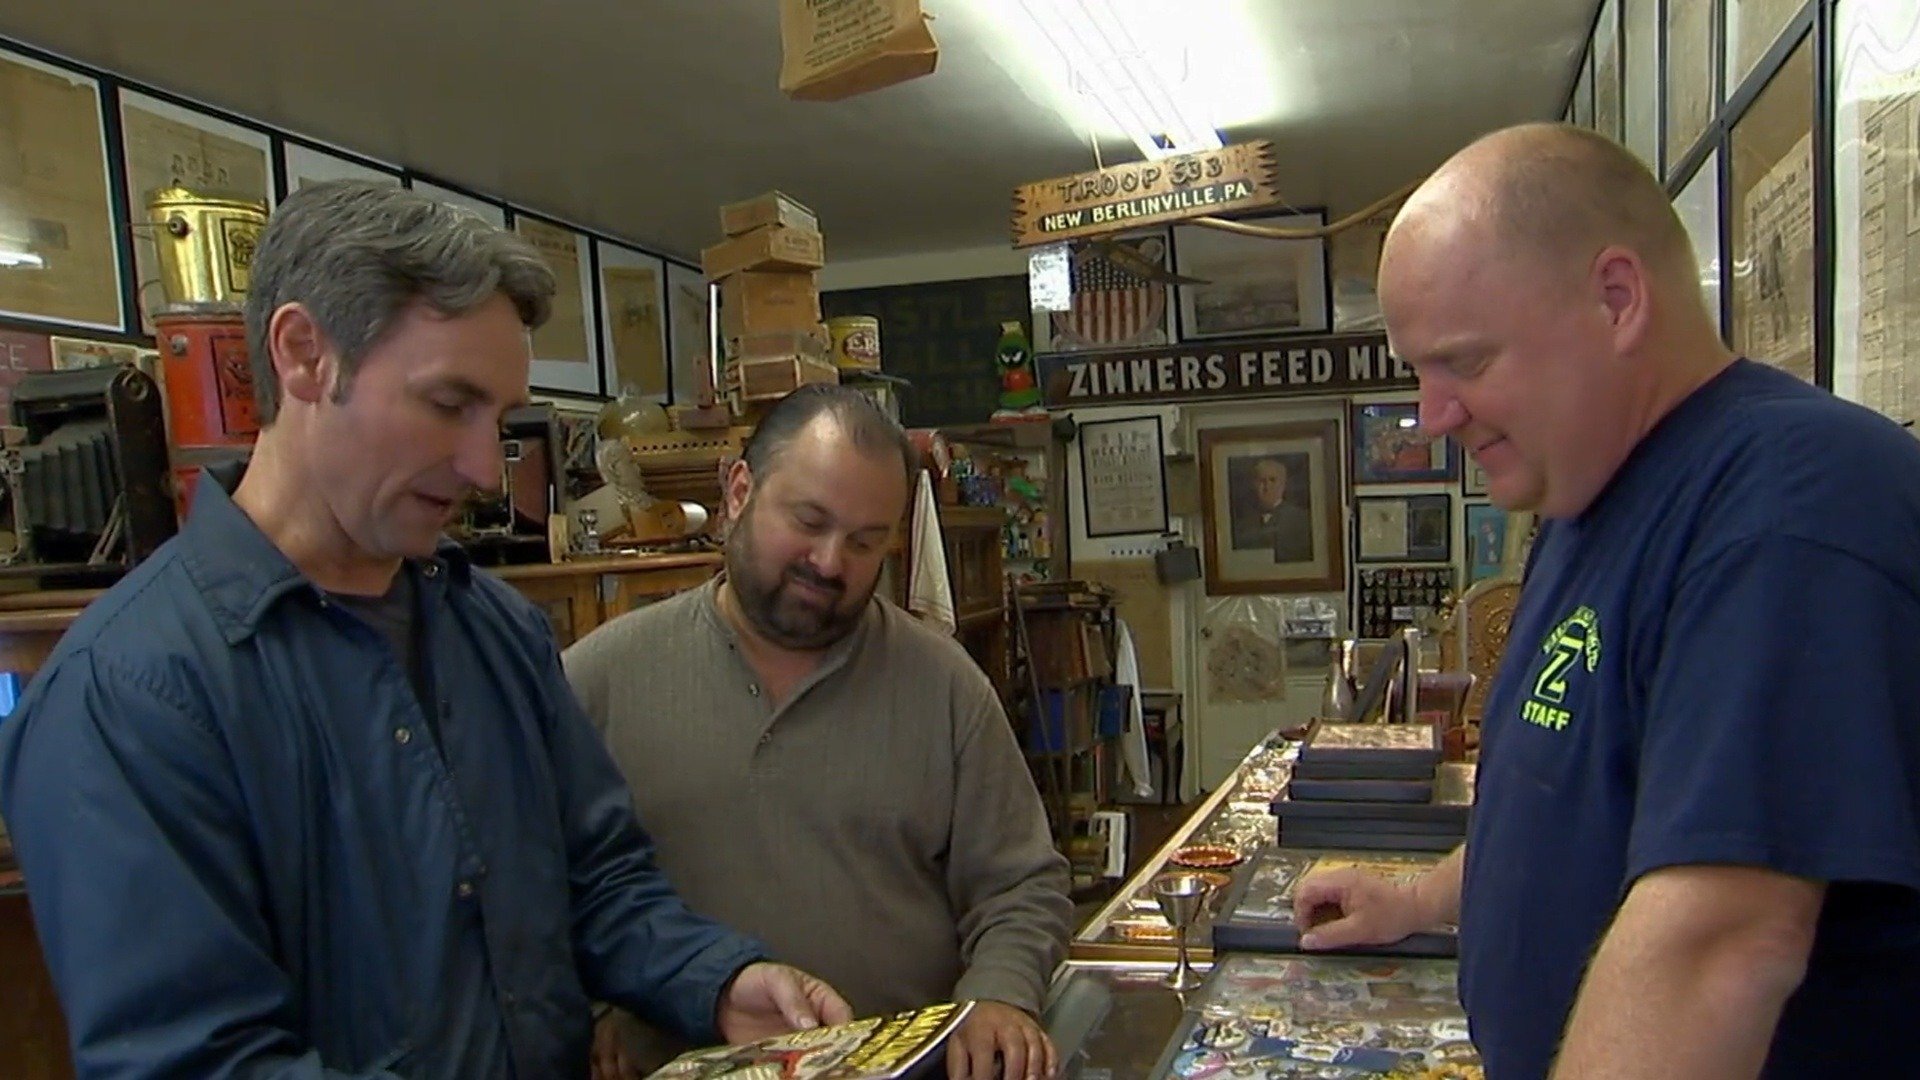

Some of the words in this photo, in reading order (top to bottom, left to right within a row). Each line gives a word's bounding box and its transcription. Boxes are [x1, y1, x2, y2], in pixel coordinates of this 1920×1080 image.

[1057, 166, 1162, 204] TROOP
[1044, 210, 1083, 231] NEW
[1066, 353, 1227, 398] ZIMMERS
[1238, 346, 1334, 387] FEED
[1521, 699, 1571, 732] STAFF
